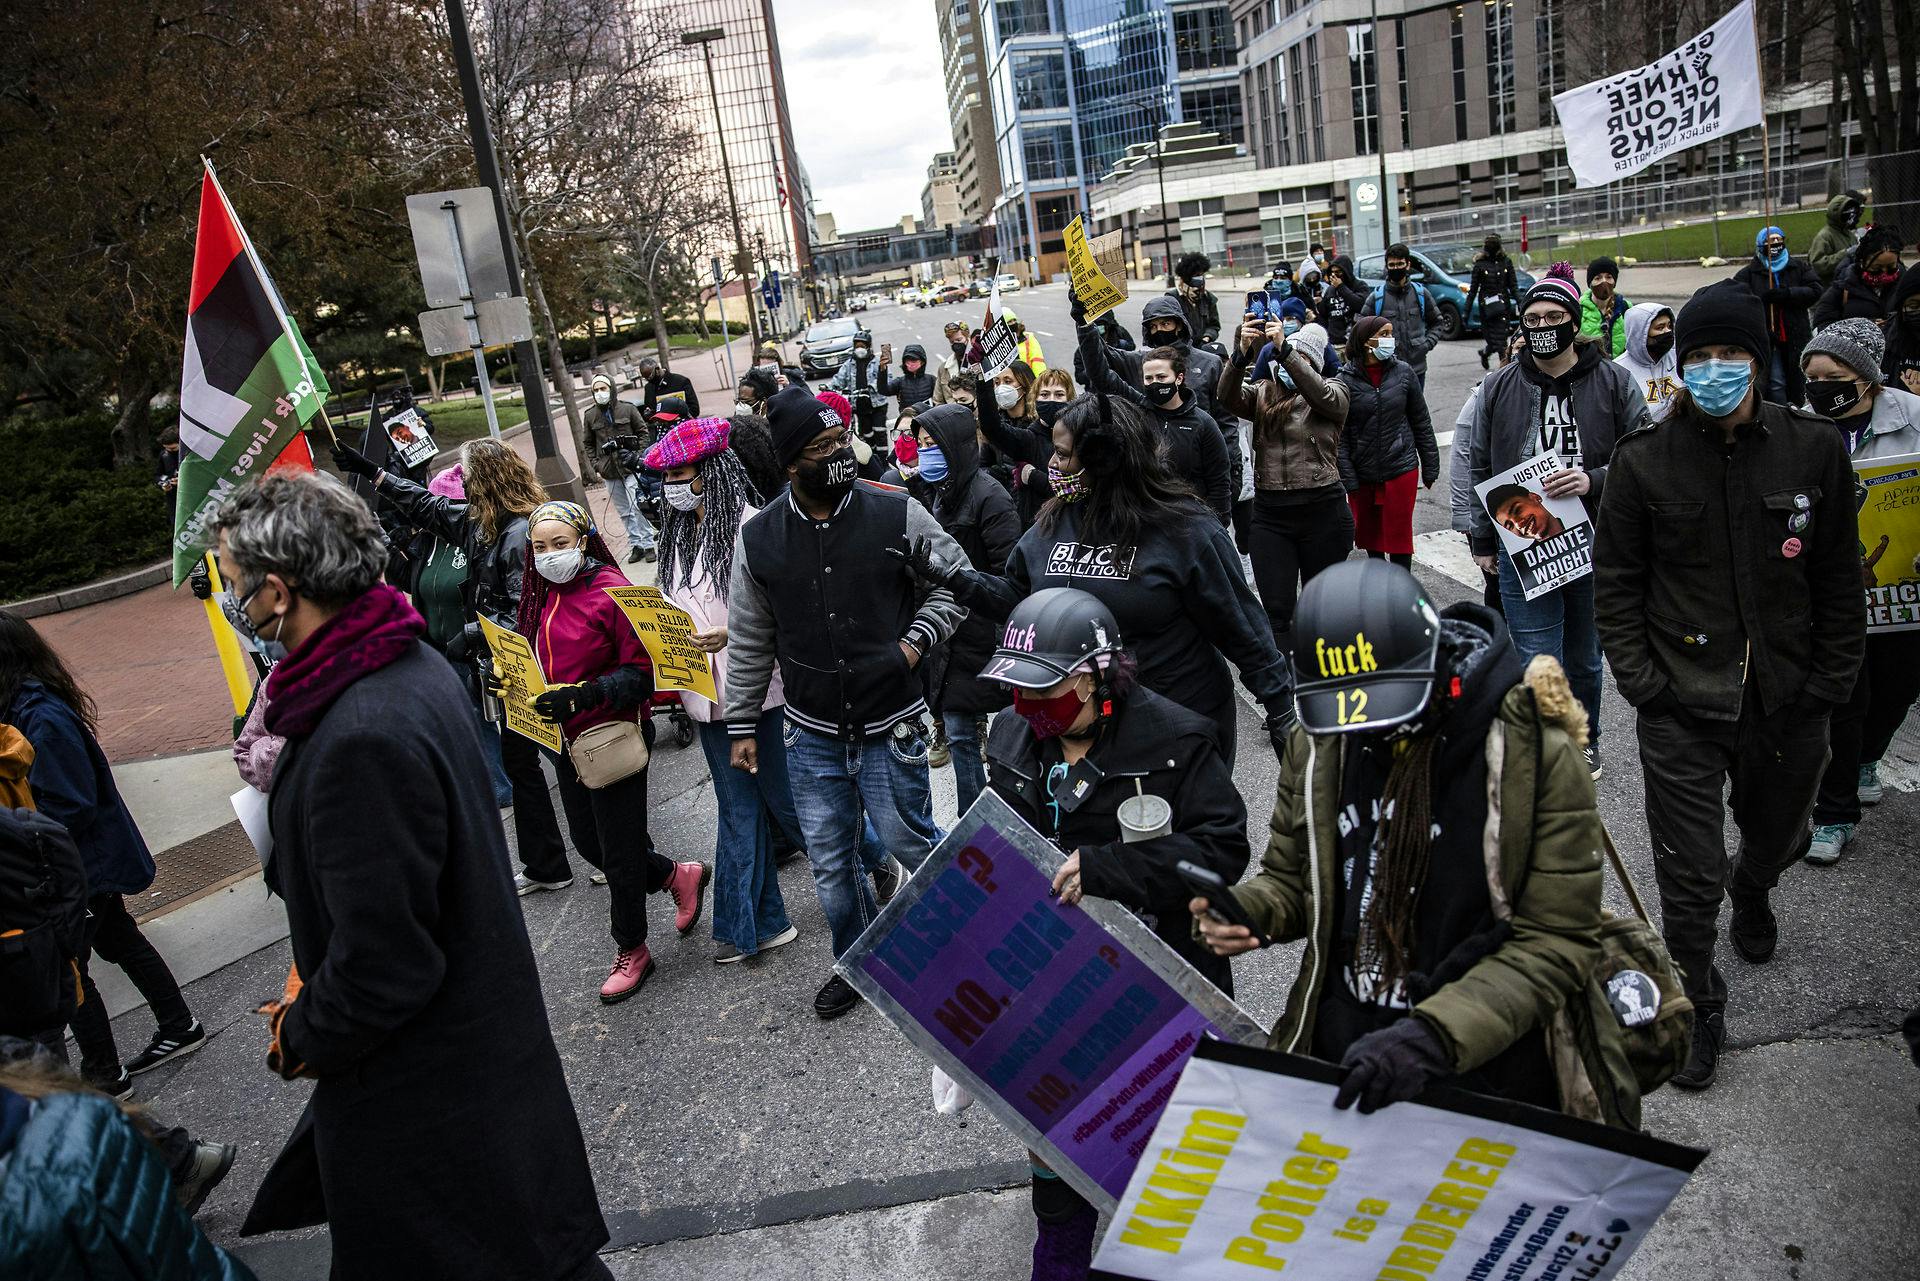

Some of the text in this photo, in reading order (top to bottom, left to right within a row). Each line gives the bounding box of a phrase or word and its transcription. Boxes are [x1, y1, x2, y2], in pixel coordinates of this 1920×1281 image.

[981, 319, 1007, 354] DAUNTE
[1530, 330, 1557, 340] BLACK
[1532, 338, 1557, 346] LIVES
[988, 336, 1014, 368] WRIGHT
[404, 437, 430, 456] DAUNTE
[408, 444, 433, 462] WRIGHT
[827, 460, 843, 485] NO
[1513, 456, 1557, 485] JUSTICE
[1052, 545, 1122, 565] BLAC
[1523, 526, 1588, 568] DAUNTE
[1532, 545, 1592, 585] WRIGHT
[638, 621, 656, 632] KIM
[656, 612, 690, 627] POTTER
[988, 657, 1016, 677] 12
[1315, 632, 1378, 677] fuck
[1336, 688, 1368, 726] 12
[879, 845, 998, 984] TASER?
[985, 900, 1076, 993] GUN
[984, 944, 1121, 1089] MANSLAUGHTER?
[1060, 983, 1159, 1081] MURDER
[1224, 1131, 1352, 1272] Potter
[1374, 1137, 1519, 1281] URDERER
